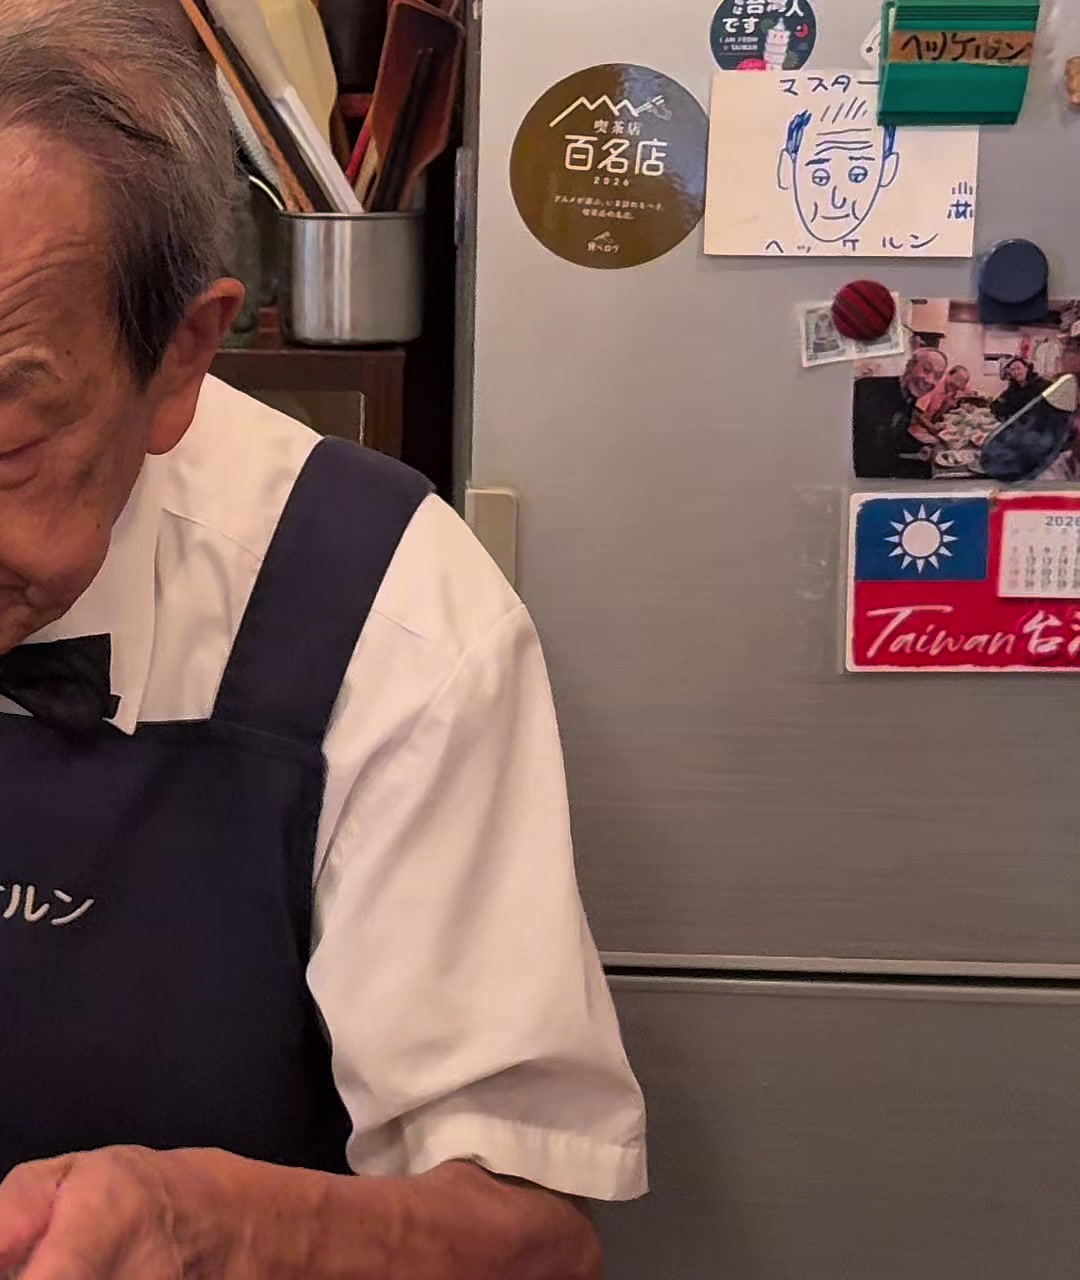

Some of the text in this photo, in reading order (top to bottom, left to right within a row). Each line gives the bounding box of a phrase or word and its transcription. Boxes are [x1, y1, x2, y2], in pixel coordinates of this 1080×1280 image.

[780, 74, 880, 96] マスター
[564, 134, 668, 176] 百名店
[866, 604, 1018, 658] Taiwan
